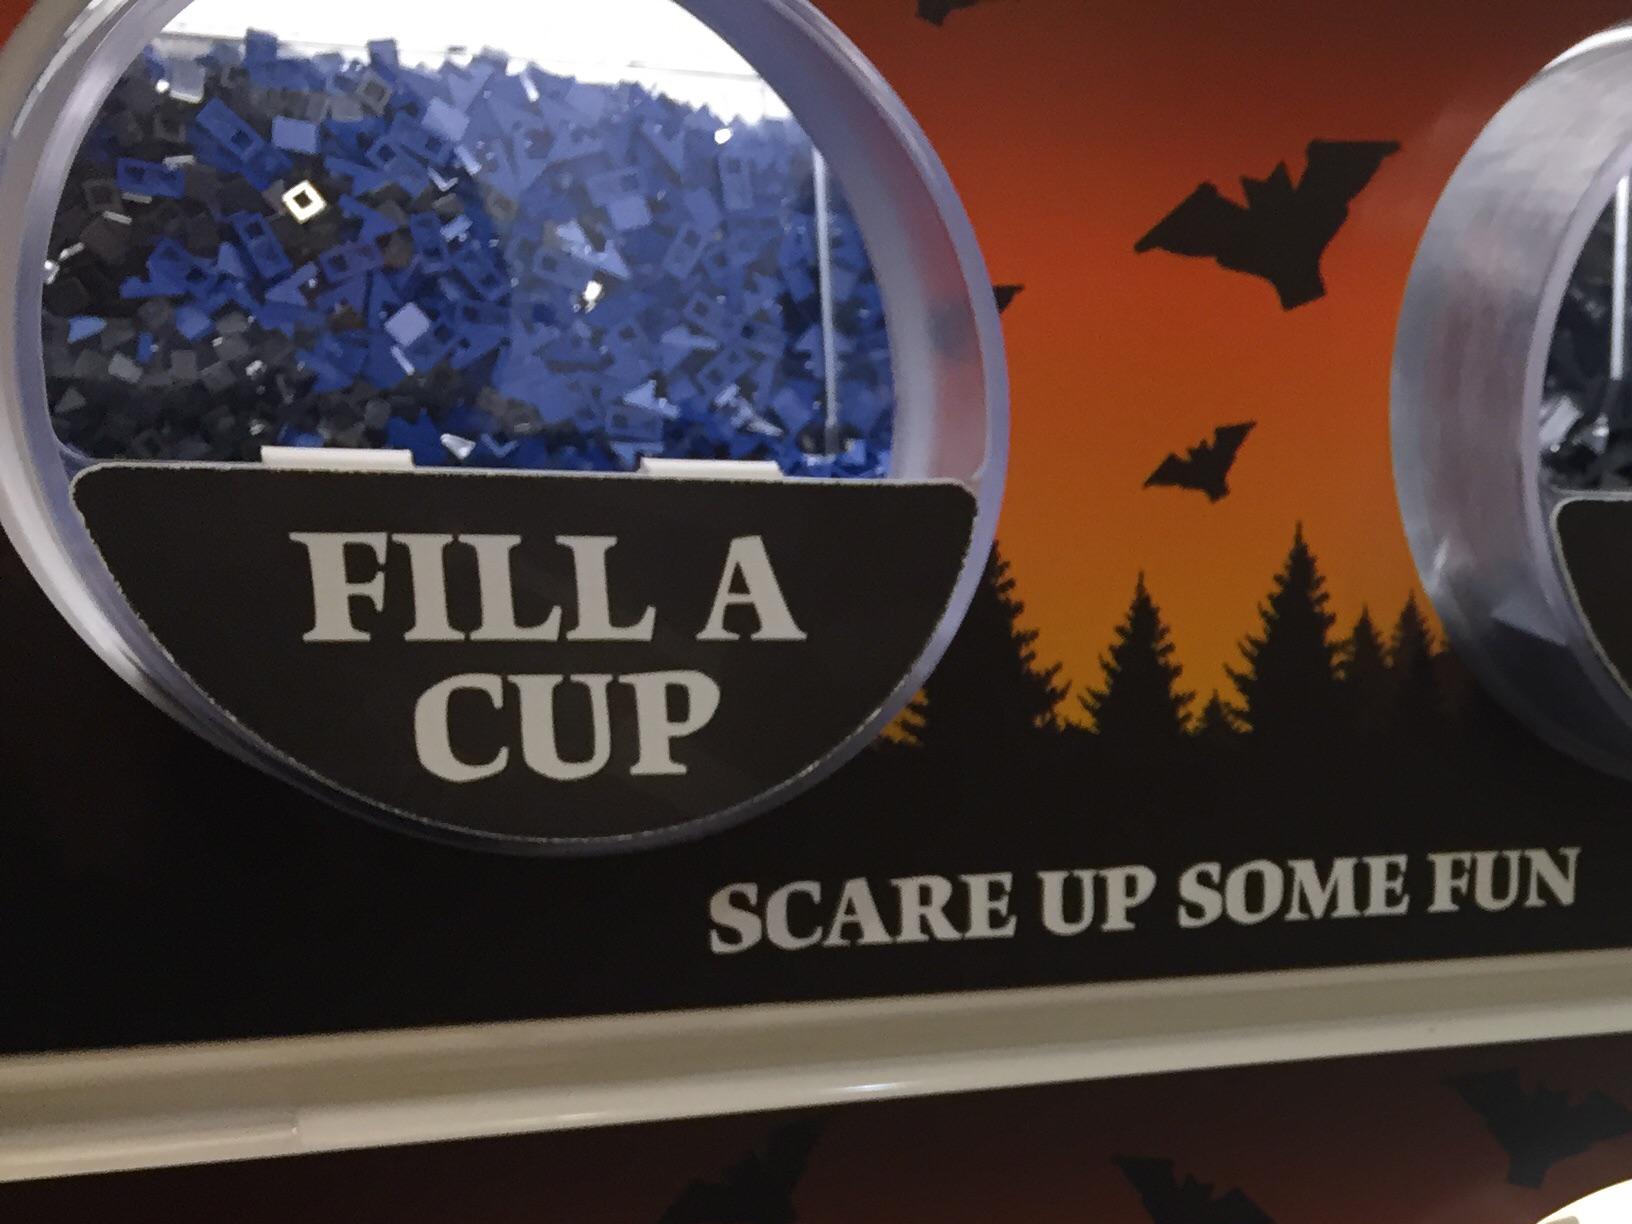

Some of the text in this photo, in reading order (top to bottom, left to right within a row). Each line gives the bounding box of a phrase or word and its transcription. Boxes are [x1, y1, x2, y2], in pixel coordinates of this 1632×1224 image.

[289, 531, 808, 642] FILL A
[413, 669, 721, 783] CUP
[708, 846, 1583, 956] SCARE UP SOME FUN
